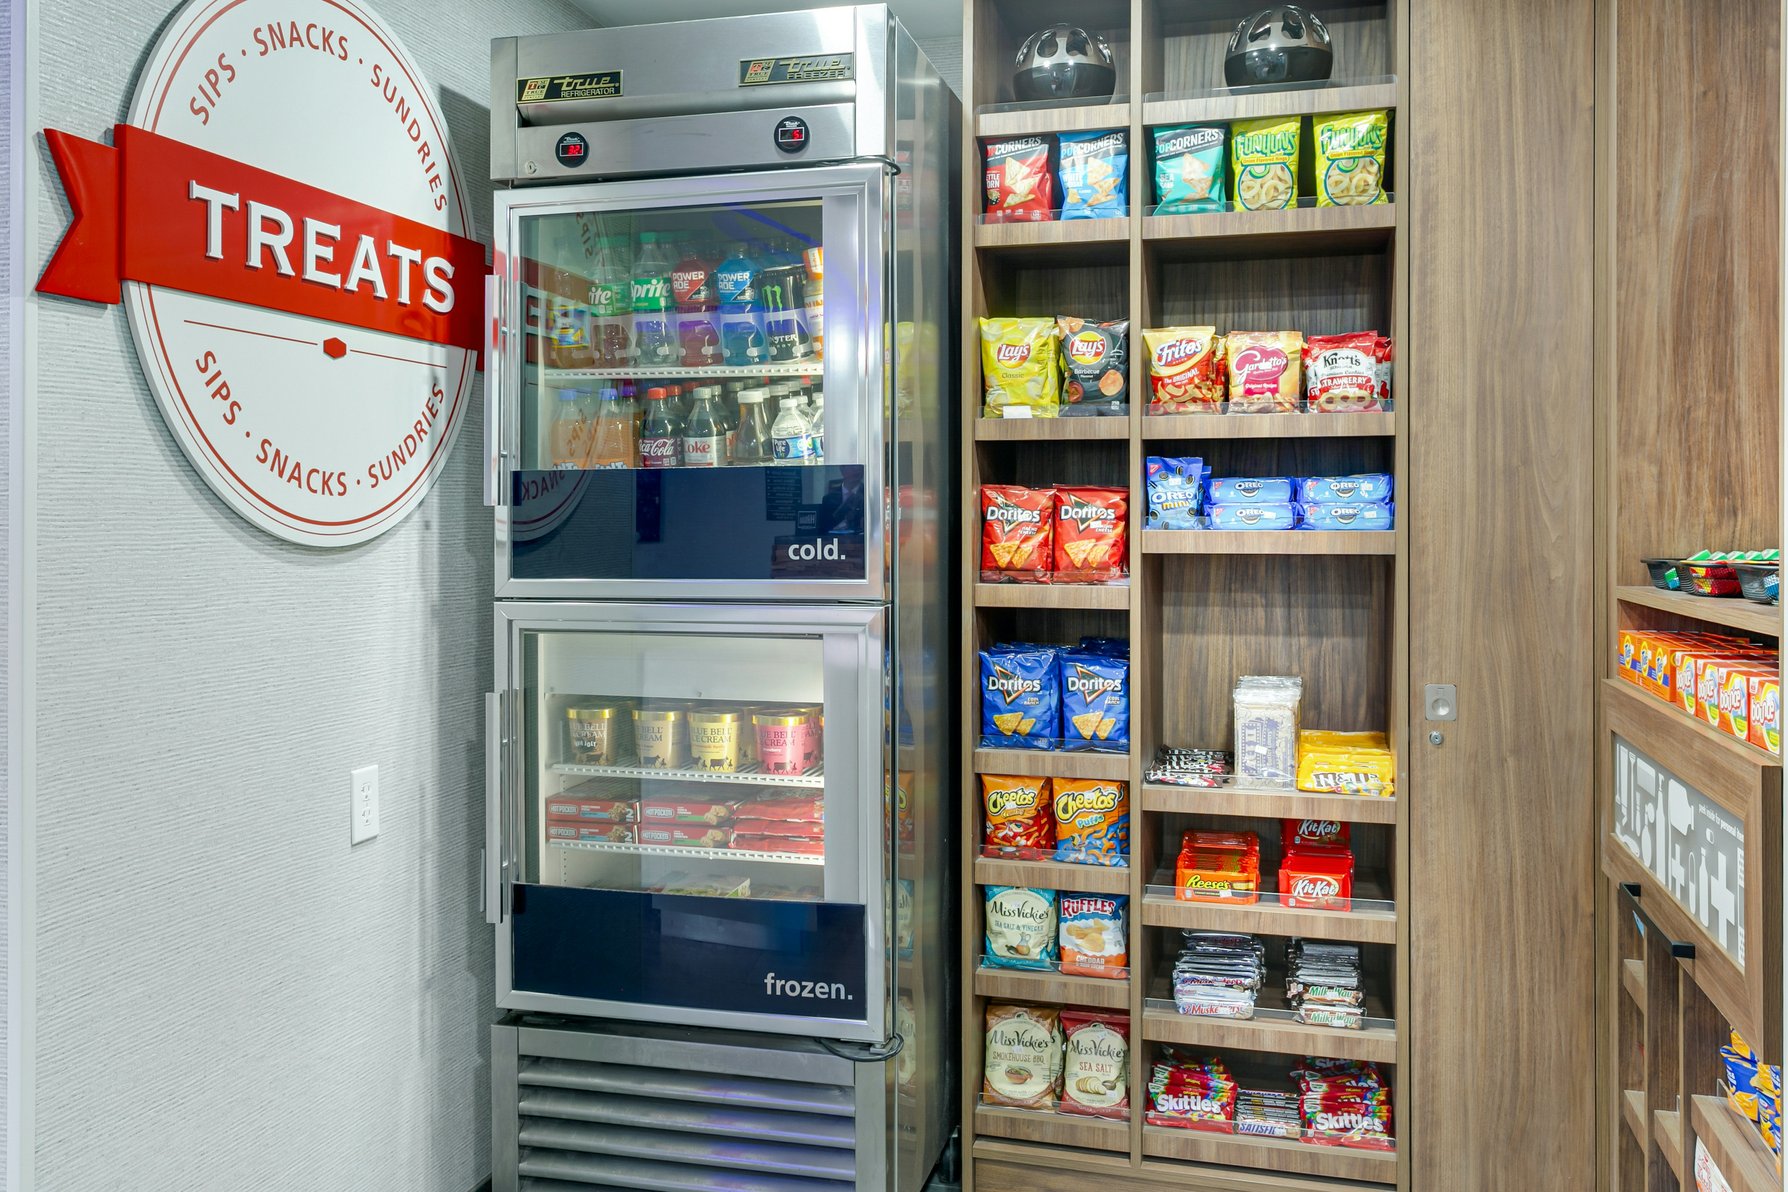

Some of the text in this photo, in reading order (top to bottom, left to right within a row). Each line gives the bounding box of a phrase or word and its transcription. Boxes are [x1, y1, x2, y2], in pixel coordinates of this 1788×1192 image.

[787, 70, 845, 80] FREEZER
[561, 88, 615, 97] REFRIGERATOR
[190, 21, 447, 212] SIPS SNACKS SUNDRIES
[987, 180, 1000, 188] ORN
[1160, 174, 1174, 182] SEA
[189, 179, 455, 313] TREATS
[672, 271, 705, 281] POWER
[718, 271, 750, 282] POWER
[999, 344, 1030, 362] Lay's
[1071, 340, 1105, 357] Lay's
[1156, 339, 1203, 366] Fritos
[1172, 368, 1200, 382] ORIGINAL
[1320, 376, 1367, 387] STRAWBERRY
[196, 350, 444, 497] SIPS SNACKS SUNDRIES
[687, 441, 710, 454] oke
[1235, 481, 1264, 490] OREO
[1330, 482, 1360, 491] OREO
[1151, 490, 1194, 504] OREO
[1162, 500, 1190, 511] mini
[1236, 508, 1265, 517] OREO
[1331, 508, 1361, 516] OREO
[987, 506, 1041, 522] Doritos
[1060, 505, 1116, 521] Doritos
[788, 538, 846, 560] cold.
[988, 676, 1041, 692] Doritos
[1068, 677, 1122, 692] Doritos
[1677, 669, 1691, 692] bounce
[1698, 678, 1714, 702] bounce
[1719, 688, 1741, 712] bounce
[1751, 698, 1776, 726] bounce
[710, 727, 732, 735] BELL
[702, 735, 732, 744] CREAM
[764, 738, 795, 747] CREAM
[988, 788, 1036, 815] Cheetos
[626, 808, 635, 819] 2
[1076, 814, 1105, 828] Puffs
[624, 831, 633, 842] 2
[1186, 875, 1230, 890] Reese's
[991, 900, 1049, 923] Miss Vickie's
[1061, 898, 1116, 917] RUFFLES
[1003, 922, 1015, 930] SALT
[1022, 924, 1044, 932] VINEGAR
[1076, 955, 1105, 964] CHEDDAR
[764, 973, 853, 1001] frozen.
[990, 1029, 1049, 1053] Miss Vickie's
[992, 1051, 1045, 1064] SMOKEHOUSE BBQ
[1070, 1039, 1125, 1062] Miss Vickie's
[1079, 1062, 1113, 1073] SEA SALT
[1157, 1093, 1221, 1113] Skittles
[1316, 1112, 1384, 1132] Skittles
